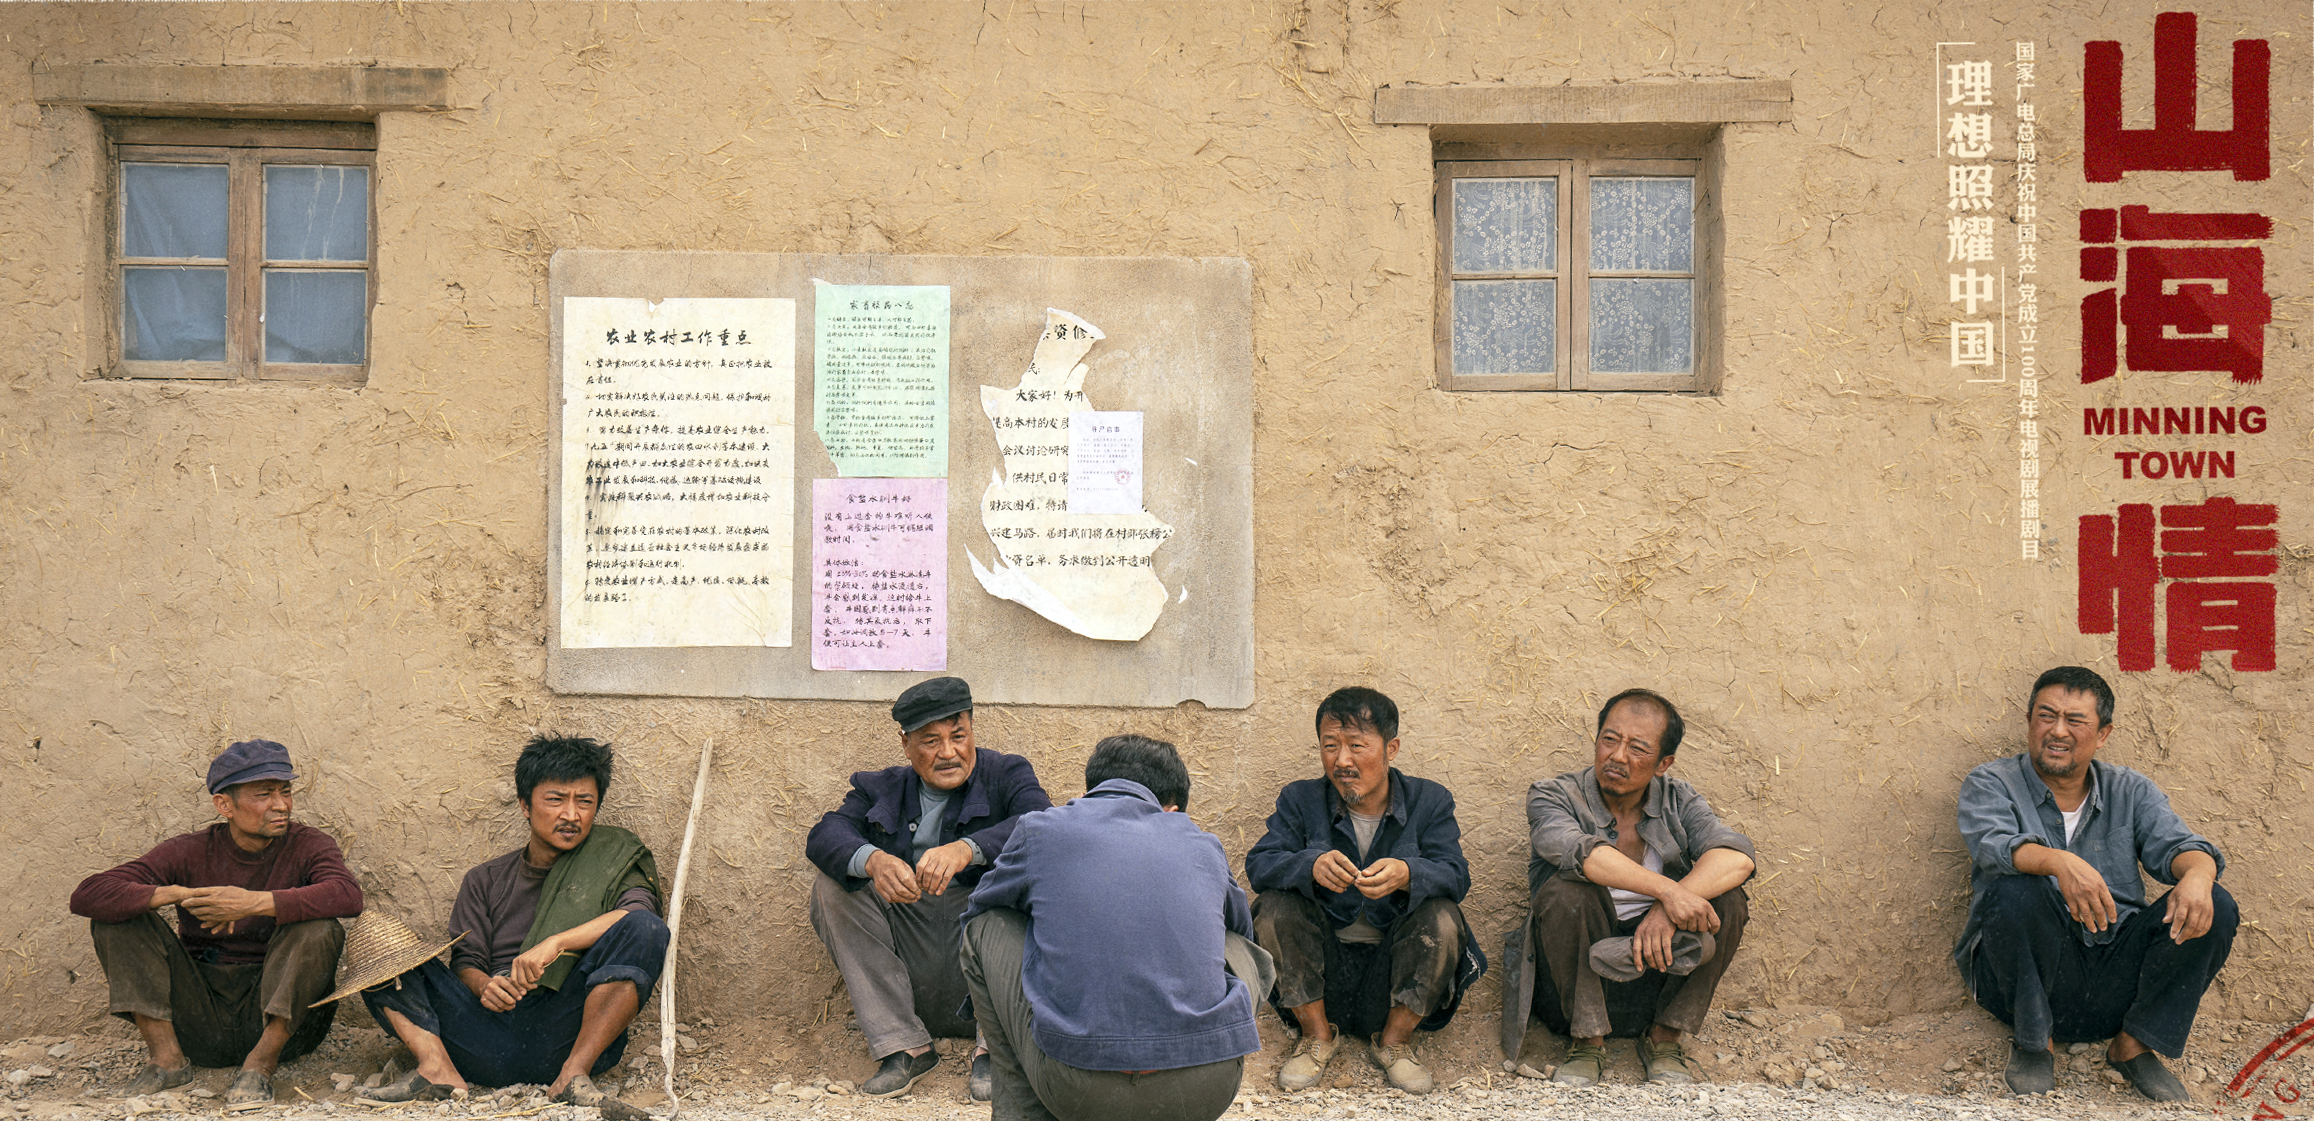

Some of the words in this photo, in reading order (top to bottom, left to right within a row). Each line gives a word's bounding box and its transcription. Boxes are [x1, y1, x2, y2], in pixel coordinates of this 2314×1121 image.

[606, 327, 752, 347] 农业农村工作重点
